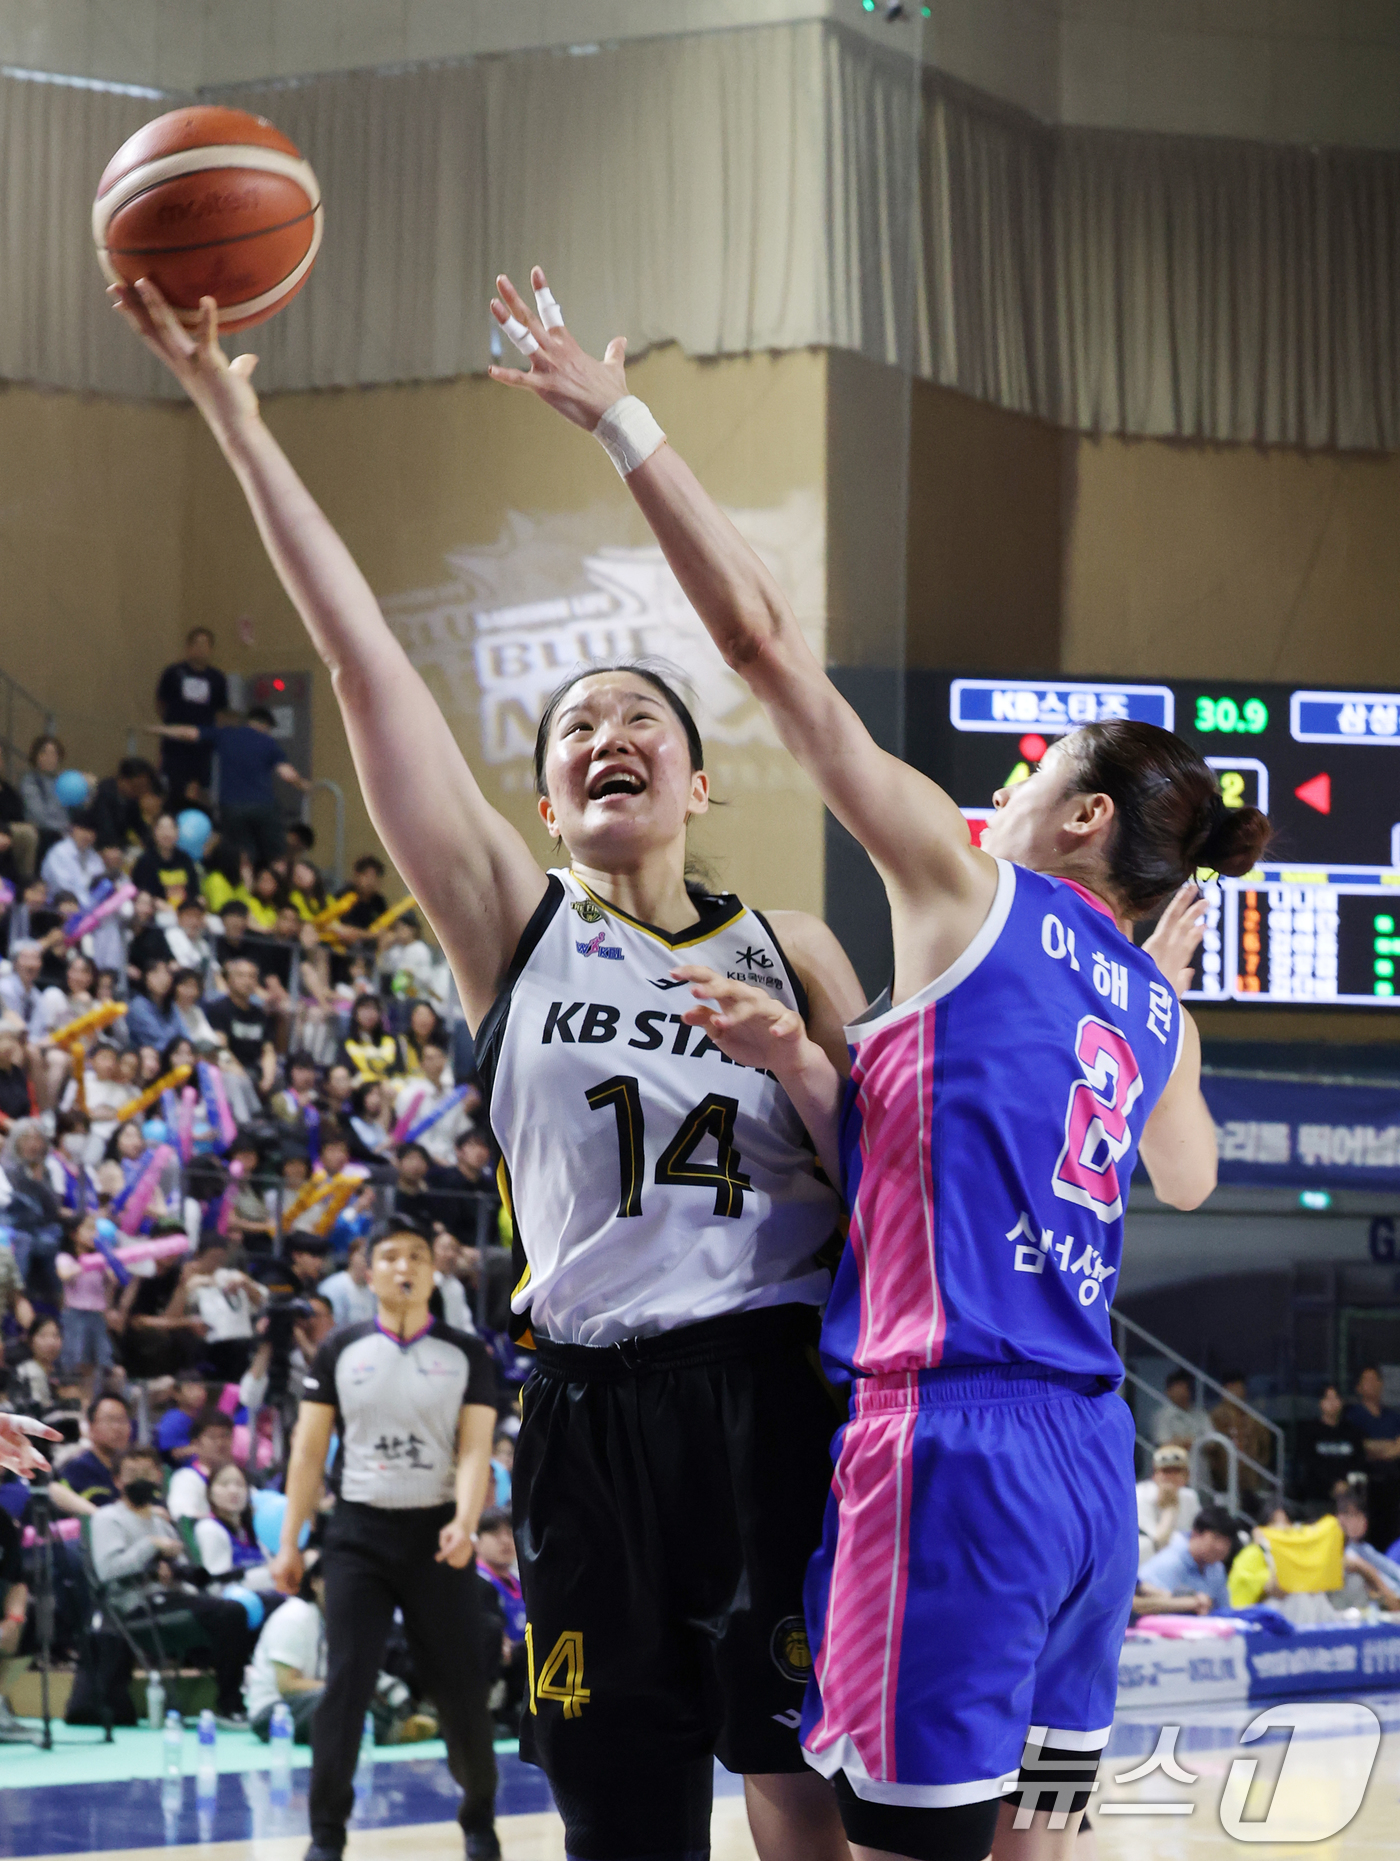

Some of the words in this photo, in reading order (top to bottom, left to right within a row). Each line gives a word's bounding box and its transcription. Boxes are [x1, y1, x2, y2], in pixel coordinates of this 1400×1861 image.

[1195, 696, 1268, 734] 30.9
[727, 971, 746, 981] KB
[541, 1001, 621, 1045] KB
[628, 1010, 779, 1083] STA
[584, 1075, 754, 1218] 14
[1051, 1014, 1144, 1224] 2
